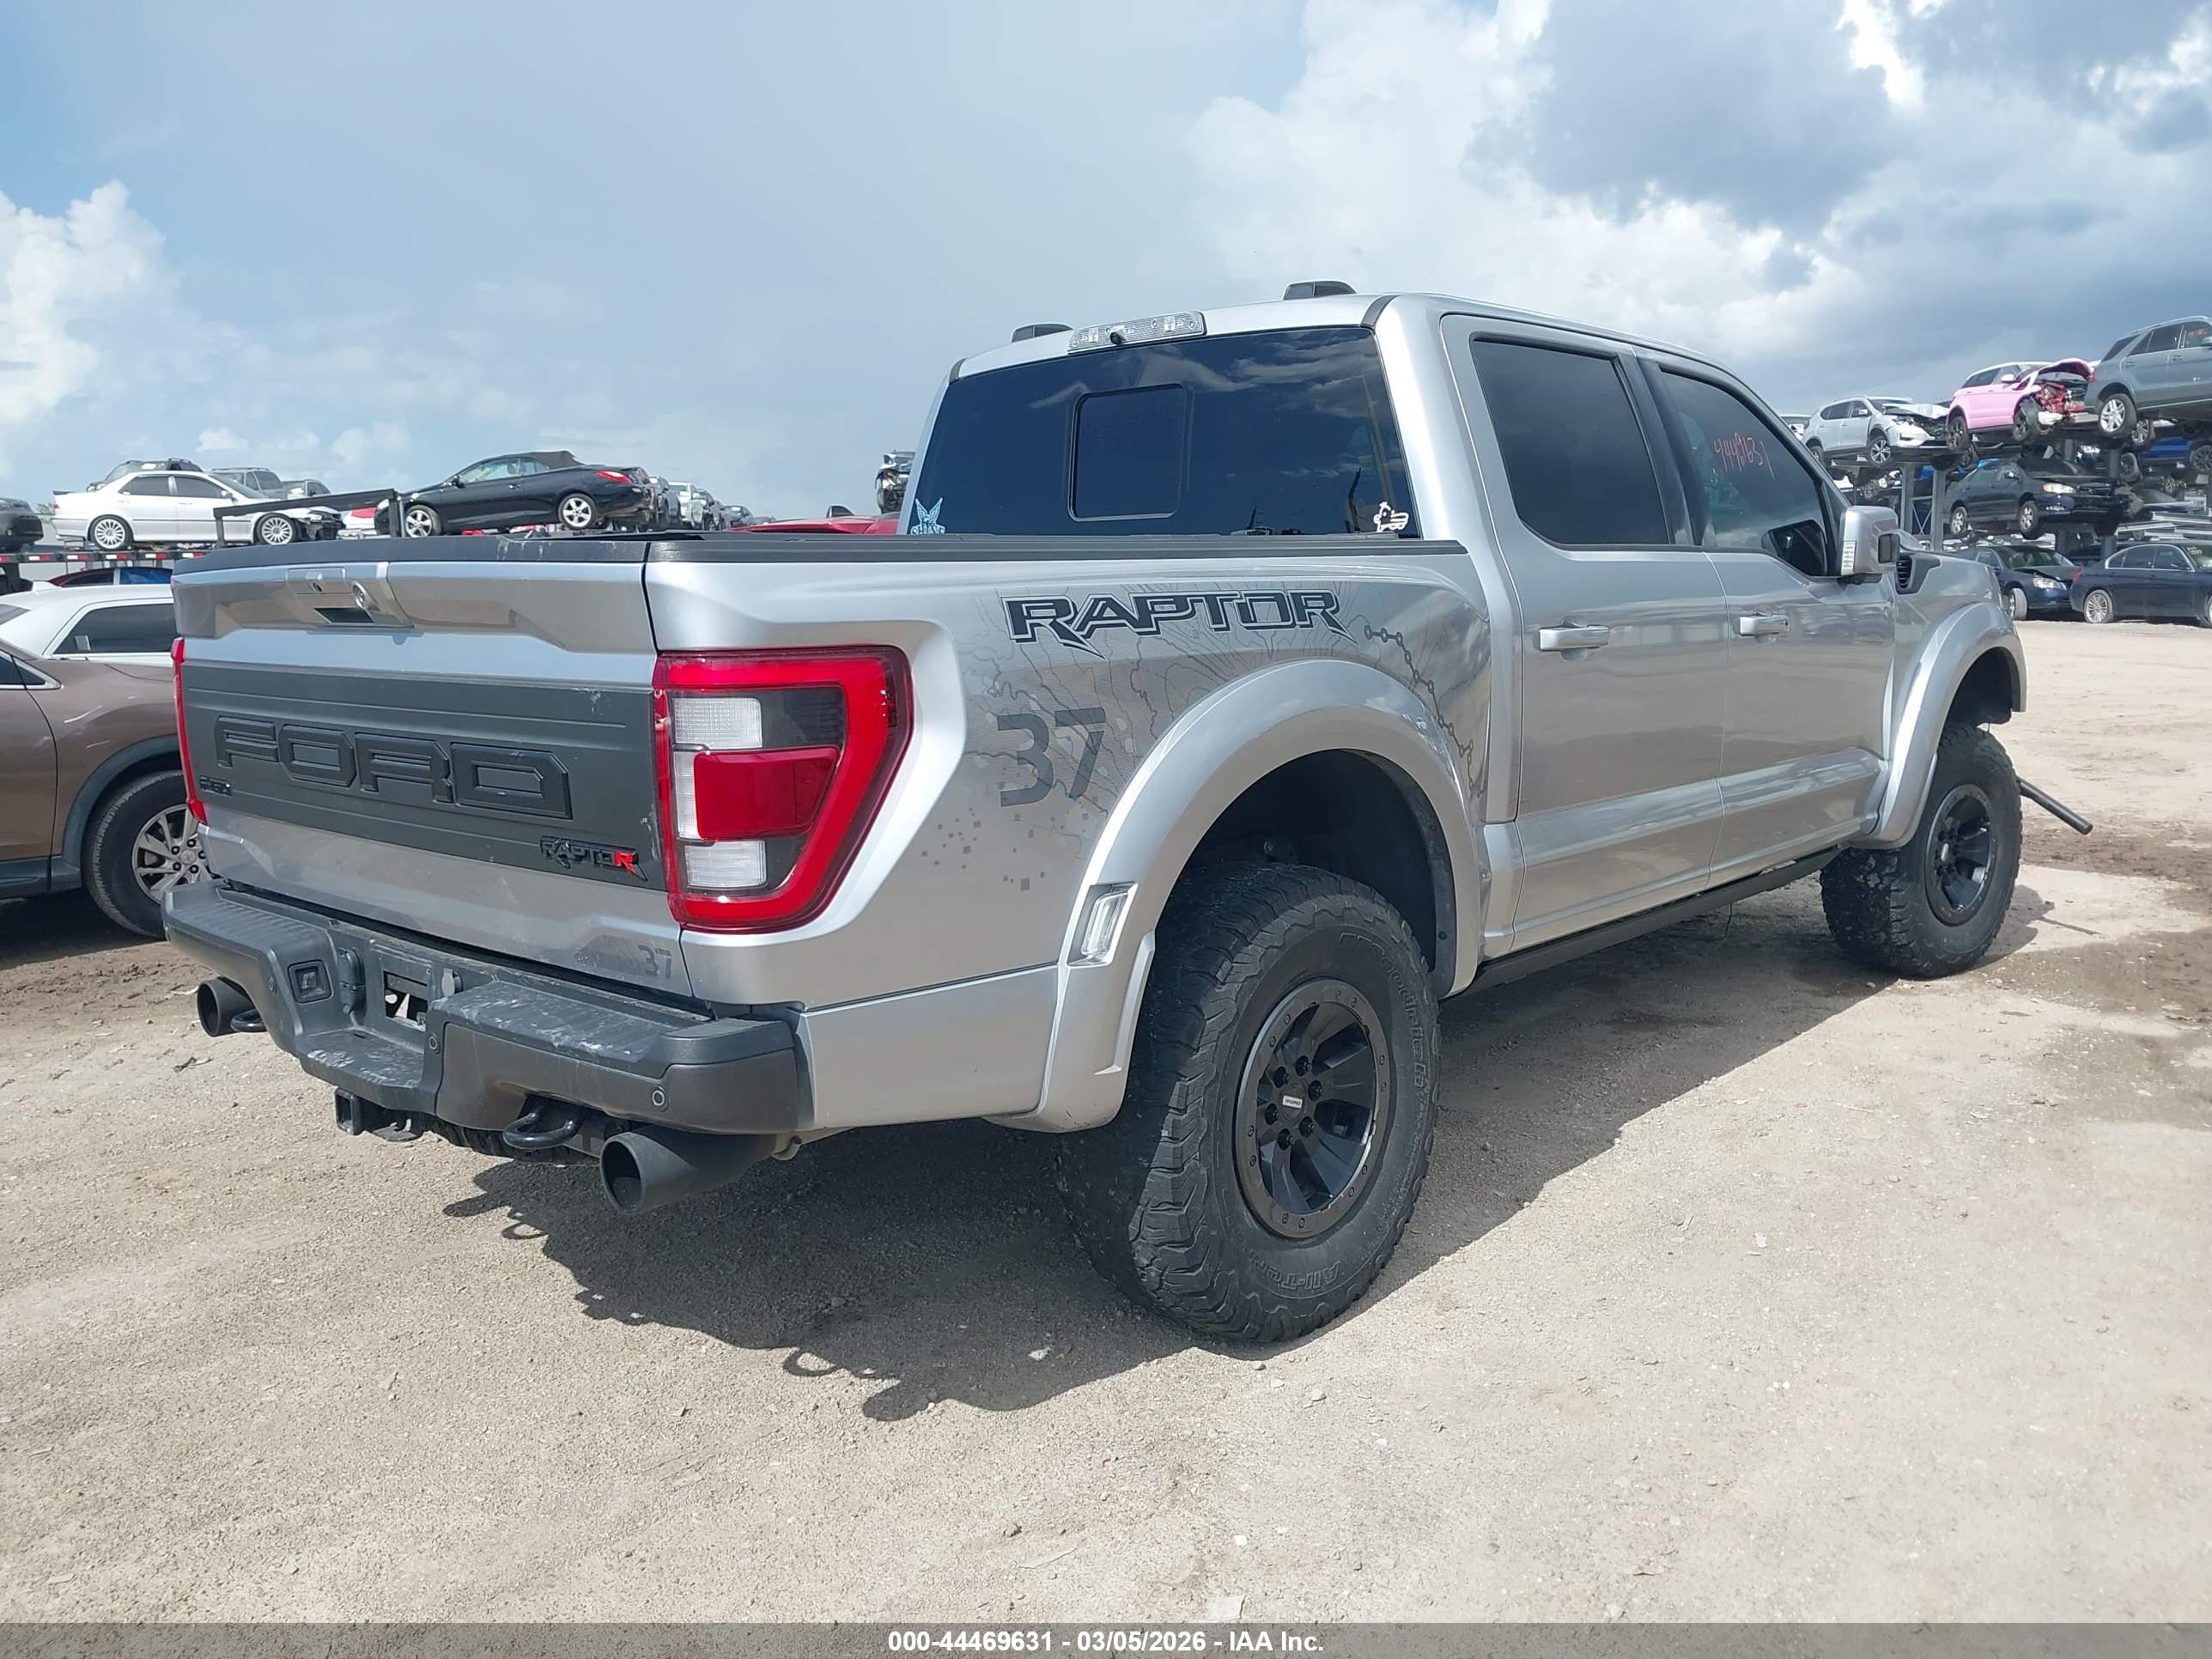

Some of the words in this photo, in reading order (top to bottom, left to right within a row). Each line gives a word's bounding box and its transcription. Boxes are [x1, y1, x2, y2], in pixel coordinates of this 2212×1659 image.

[1000, 589, 1358, 659] RAPTOR
[214, 715, 574, 819] FORD
[996, 707, 1107, 807] 37
[540, 836, 648, 881] RAPTOR
[638, 945, 672, 979] 37
